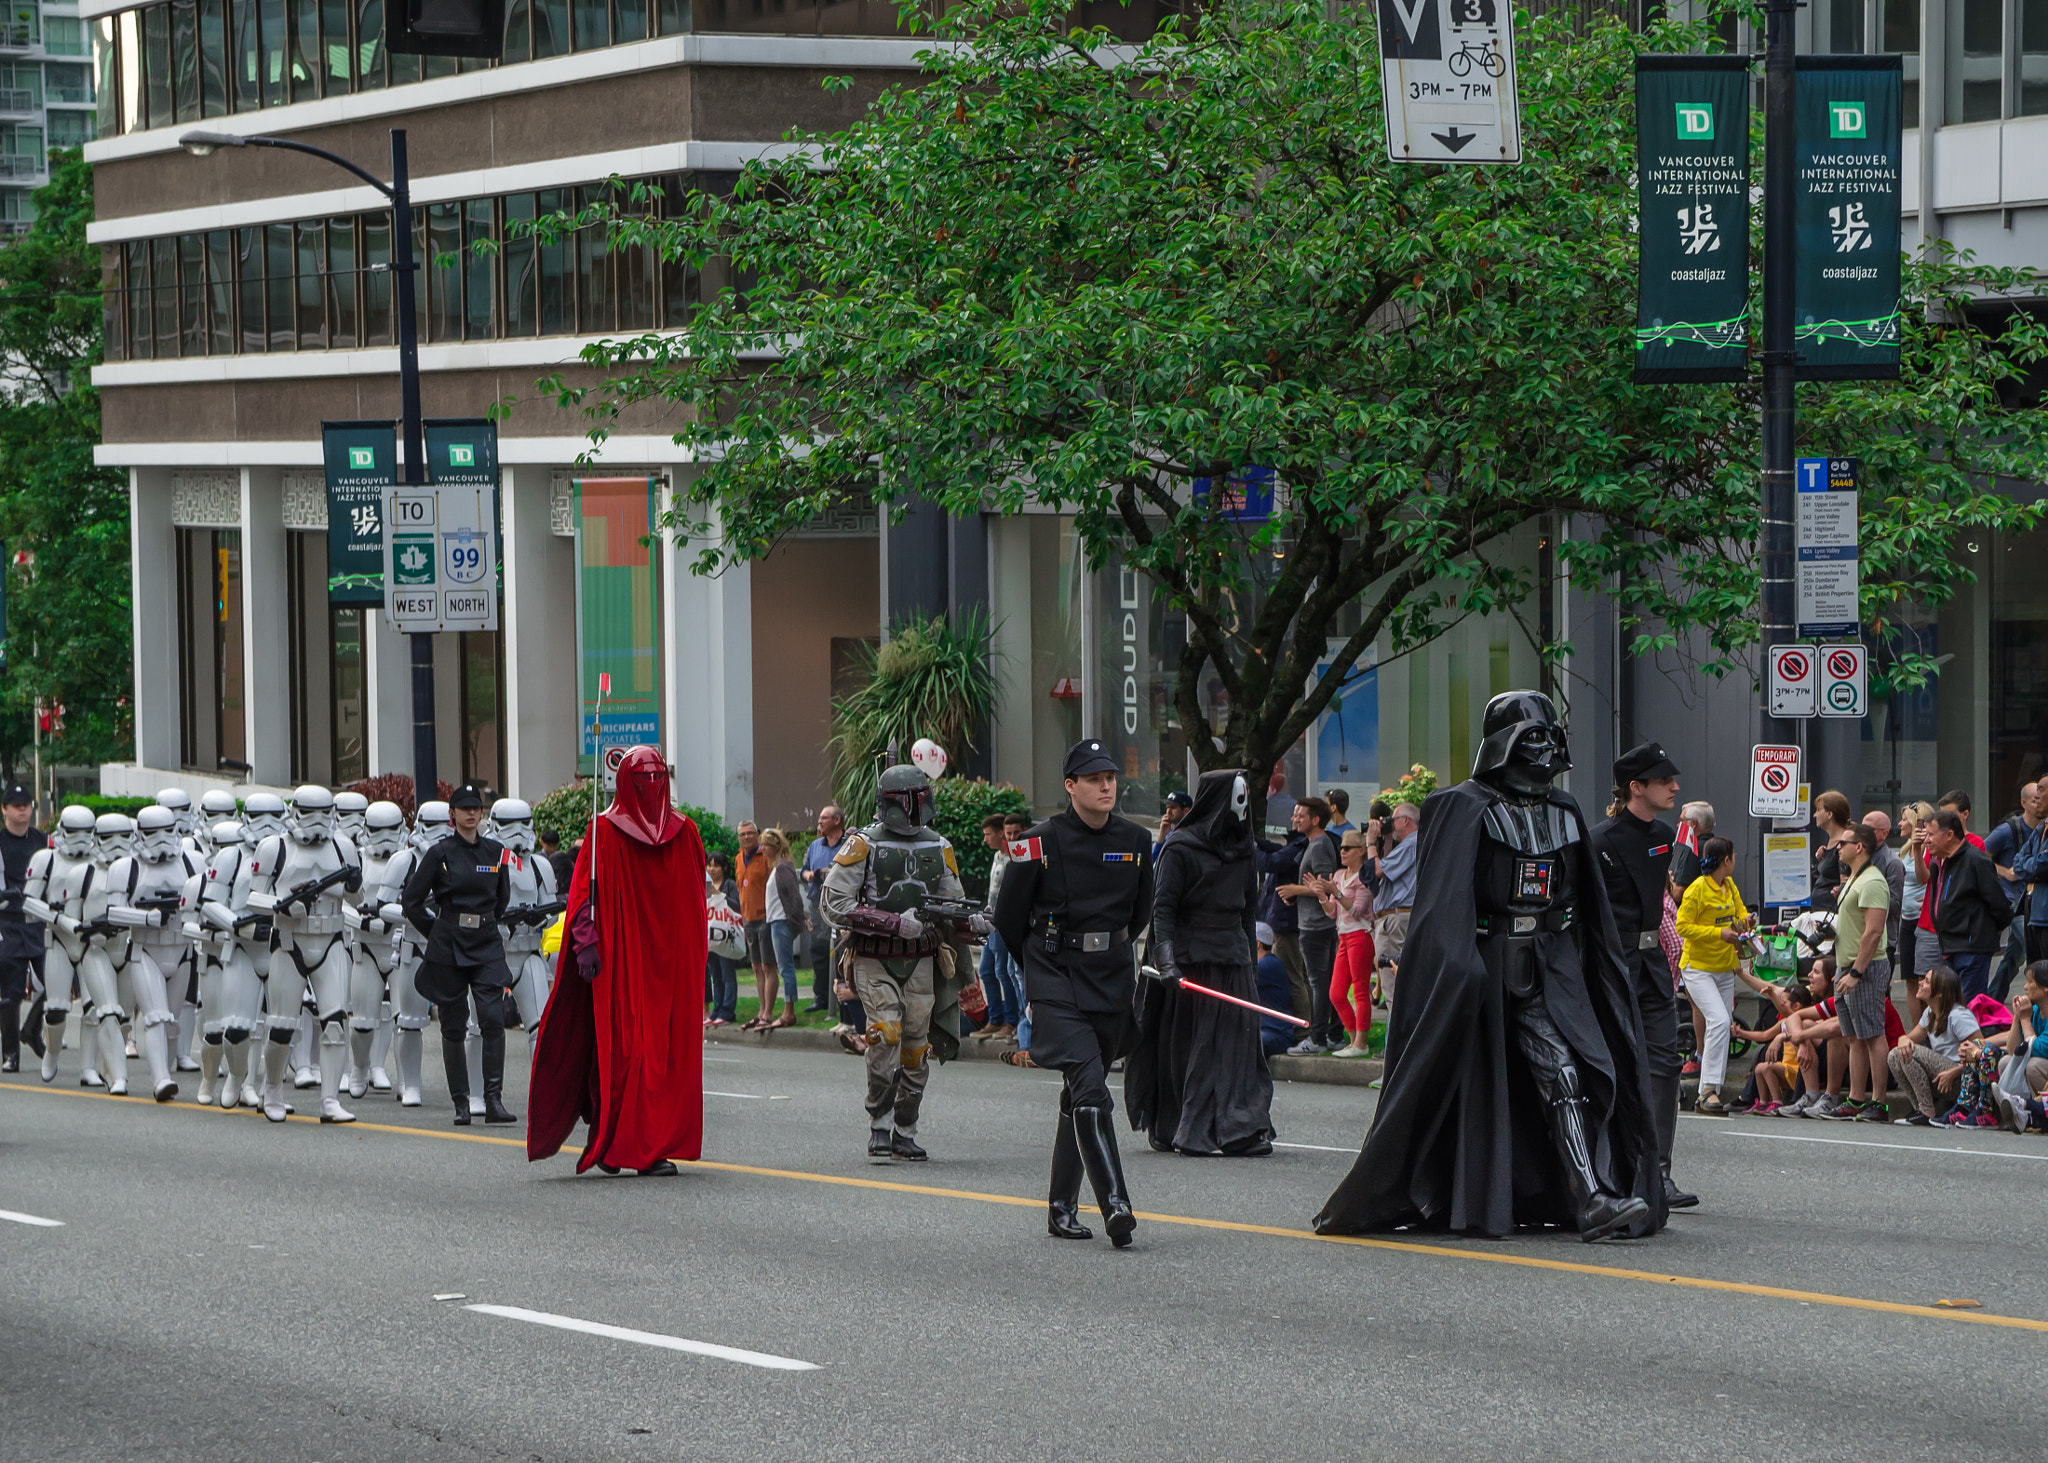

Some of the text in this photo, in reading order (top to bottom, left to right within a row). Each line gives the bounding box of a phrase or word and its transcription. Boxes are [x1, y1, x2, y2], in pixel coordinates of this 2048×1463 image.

[1464, 0, 1482, 21] 3
[1409, 82, 1441, 100] 3PM
[1460, 83, 1492, 101] 7PM
[1679, 109, 1710, 133] TD
[1832, 108, 1863, 131] TD
[1658, 156, 1735, 167] VANCOUVER
[1812, 154, 1887, 166] VANCOUVER
[1648, 169, 1745, 181] INTERNATIONAL
[1801, 168, 1897, 180] INTERNATIONAL
[1655, 183, 1741, 195] JAZZ FESTIVAL
[1808, 182, 1892, 193] JAZZ FESTIVAL
[1671, 267, 1726, 283] coastaljazz
[1822, 266, 1878, 281] coastaljazz
[351, 450, 372, 465] TD
[451, 447, 472, 462] TD
[338, 477, 389, 485] VANCOUVER
[438, 474, 490, 482] VANCOUVER
[1803, 463, 1821, 488] T
[331, 484, 382, 494] INTERNATIO
[1830, 478, 1854, 488] 54448
[336, 493, 383, 502] JAZZ FESTIV
[399, 502, 424, 520] TO
[410, 550, 416, 566] 1
[452, 547, 480, 569] 99
[395, 600, 434, 613] WEST
[450, 599, 485, 612] NORTH
[585, 723, 655, 733] ARICHPEARS
[1757, 750, 1797, 762] TEMPORARY
